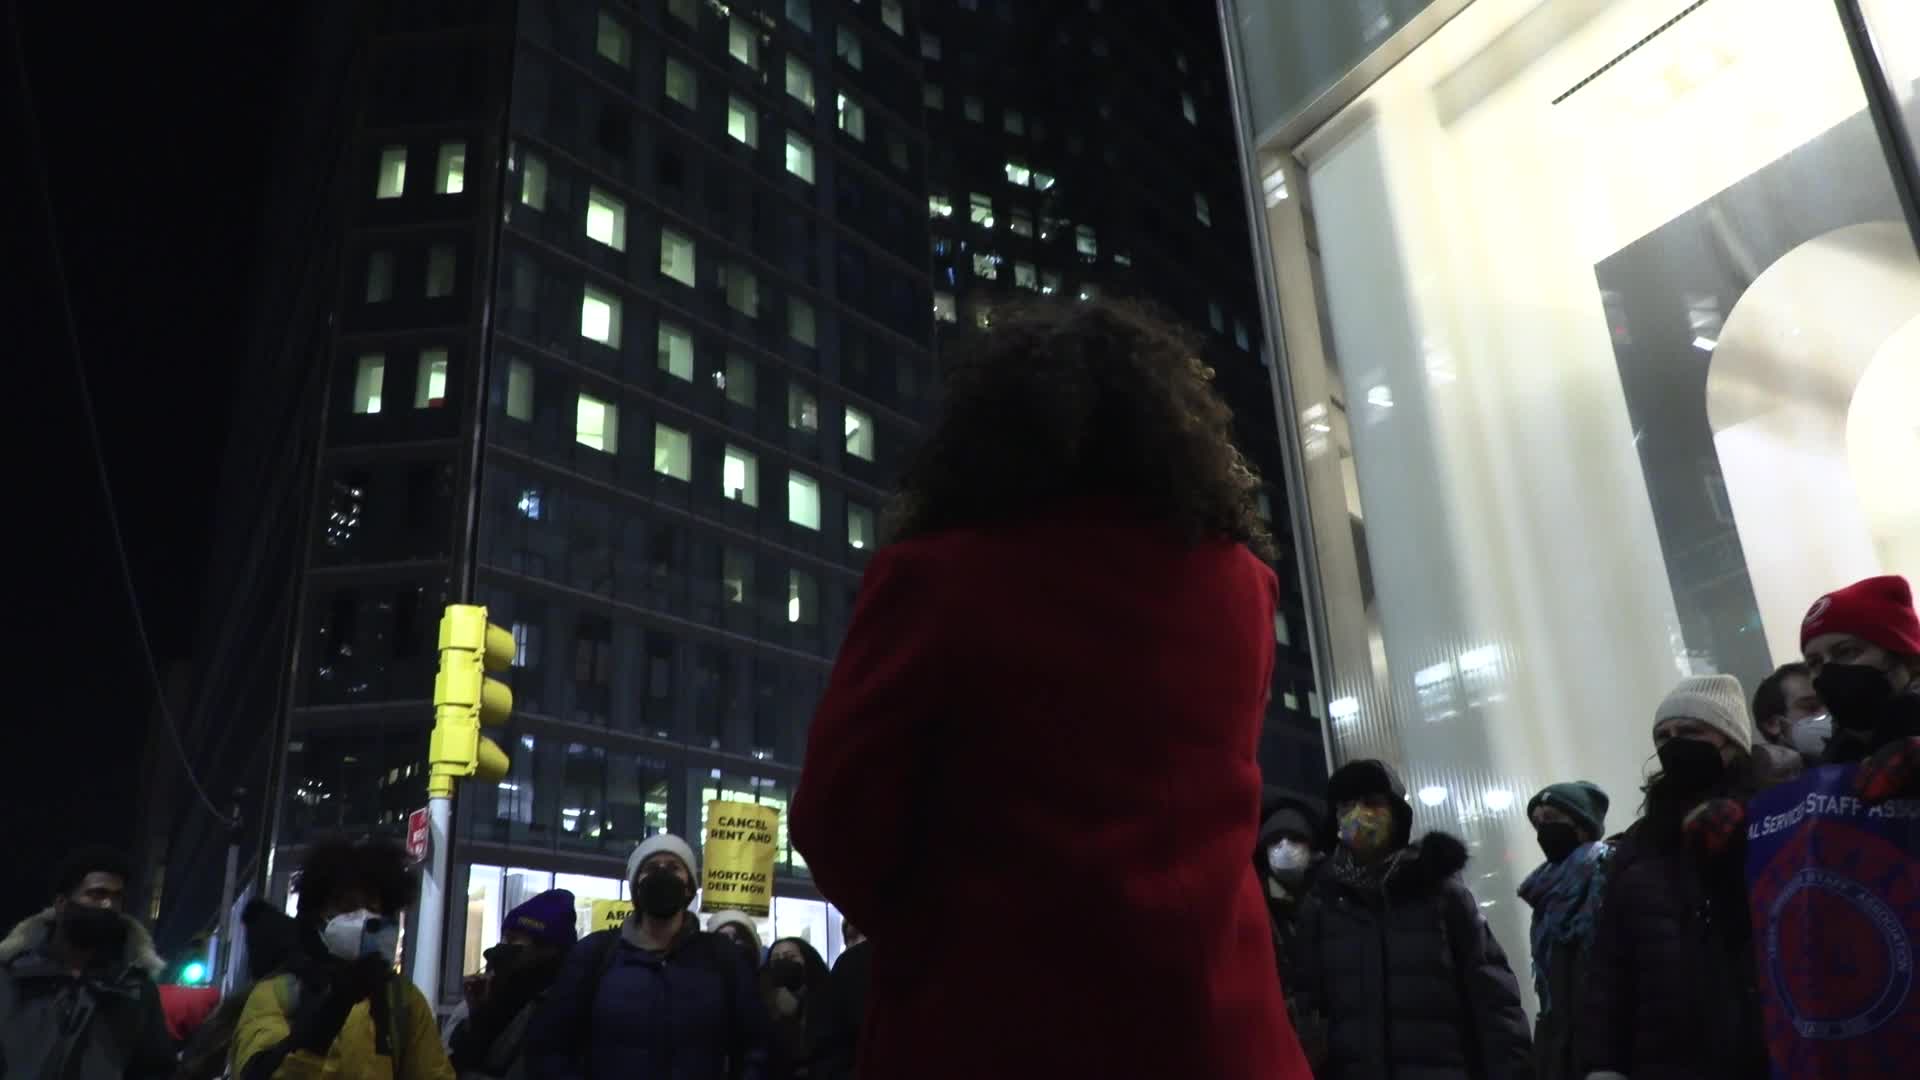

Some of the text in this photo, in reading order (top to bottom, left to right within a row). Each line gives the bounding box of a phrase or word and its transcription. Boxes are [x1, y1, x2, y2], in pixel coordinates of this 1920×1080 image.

[1805, 792, 1862, 816] STAFF
[718, 816, 768, 830] CANCEL
[711, 829, 772, 844] RENT AND
[708, 870, 766, 882] MORTGAGE
[707, 881, 765, 893] DEBT NOW
